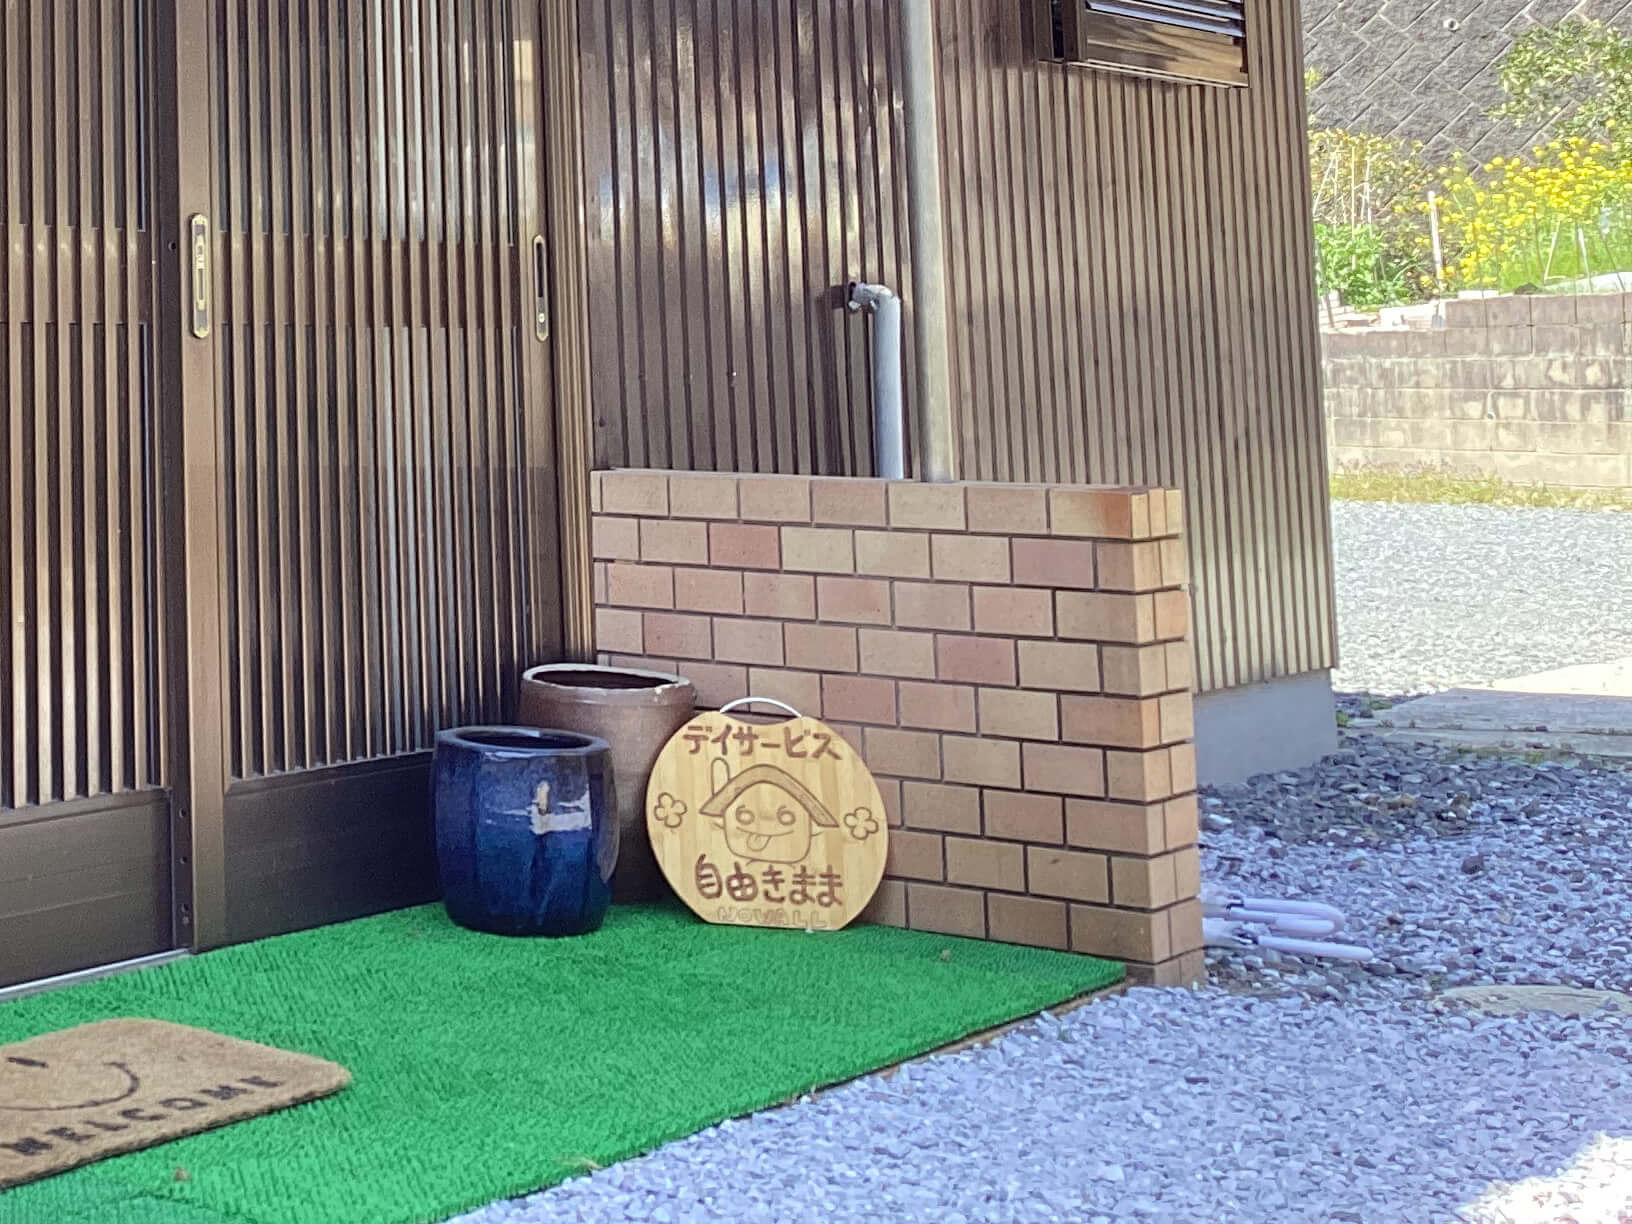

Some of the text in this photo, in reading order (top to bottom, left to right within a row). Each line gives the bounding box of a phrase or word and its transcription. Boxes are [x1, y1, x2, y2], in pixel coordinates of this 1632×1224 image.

[683, 724, 843, 760] デイサービス
[695, 853, 844, 908] 自由きまま
